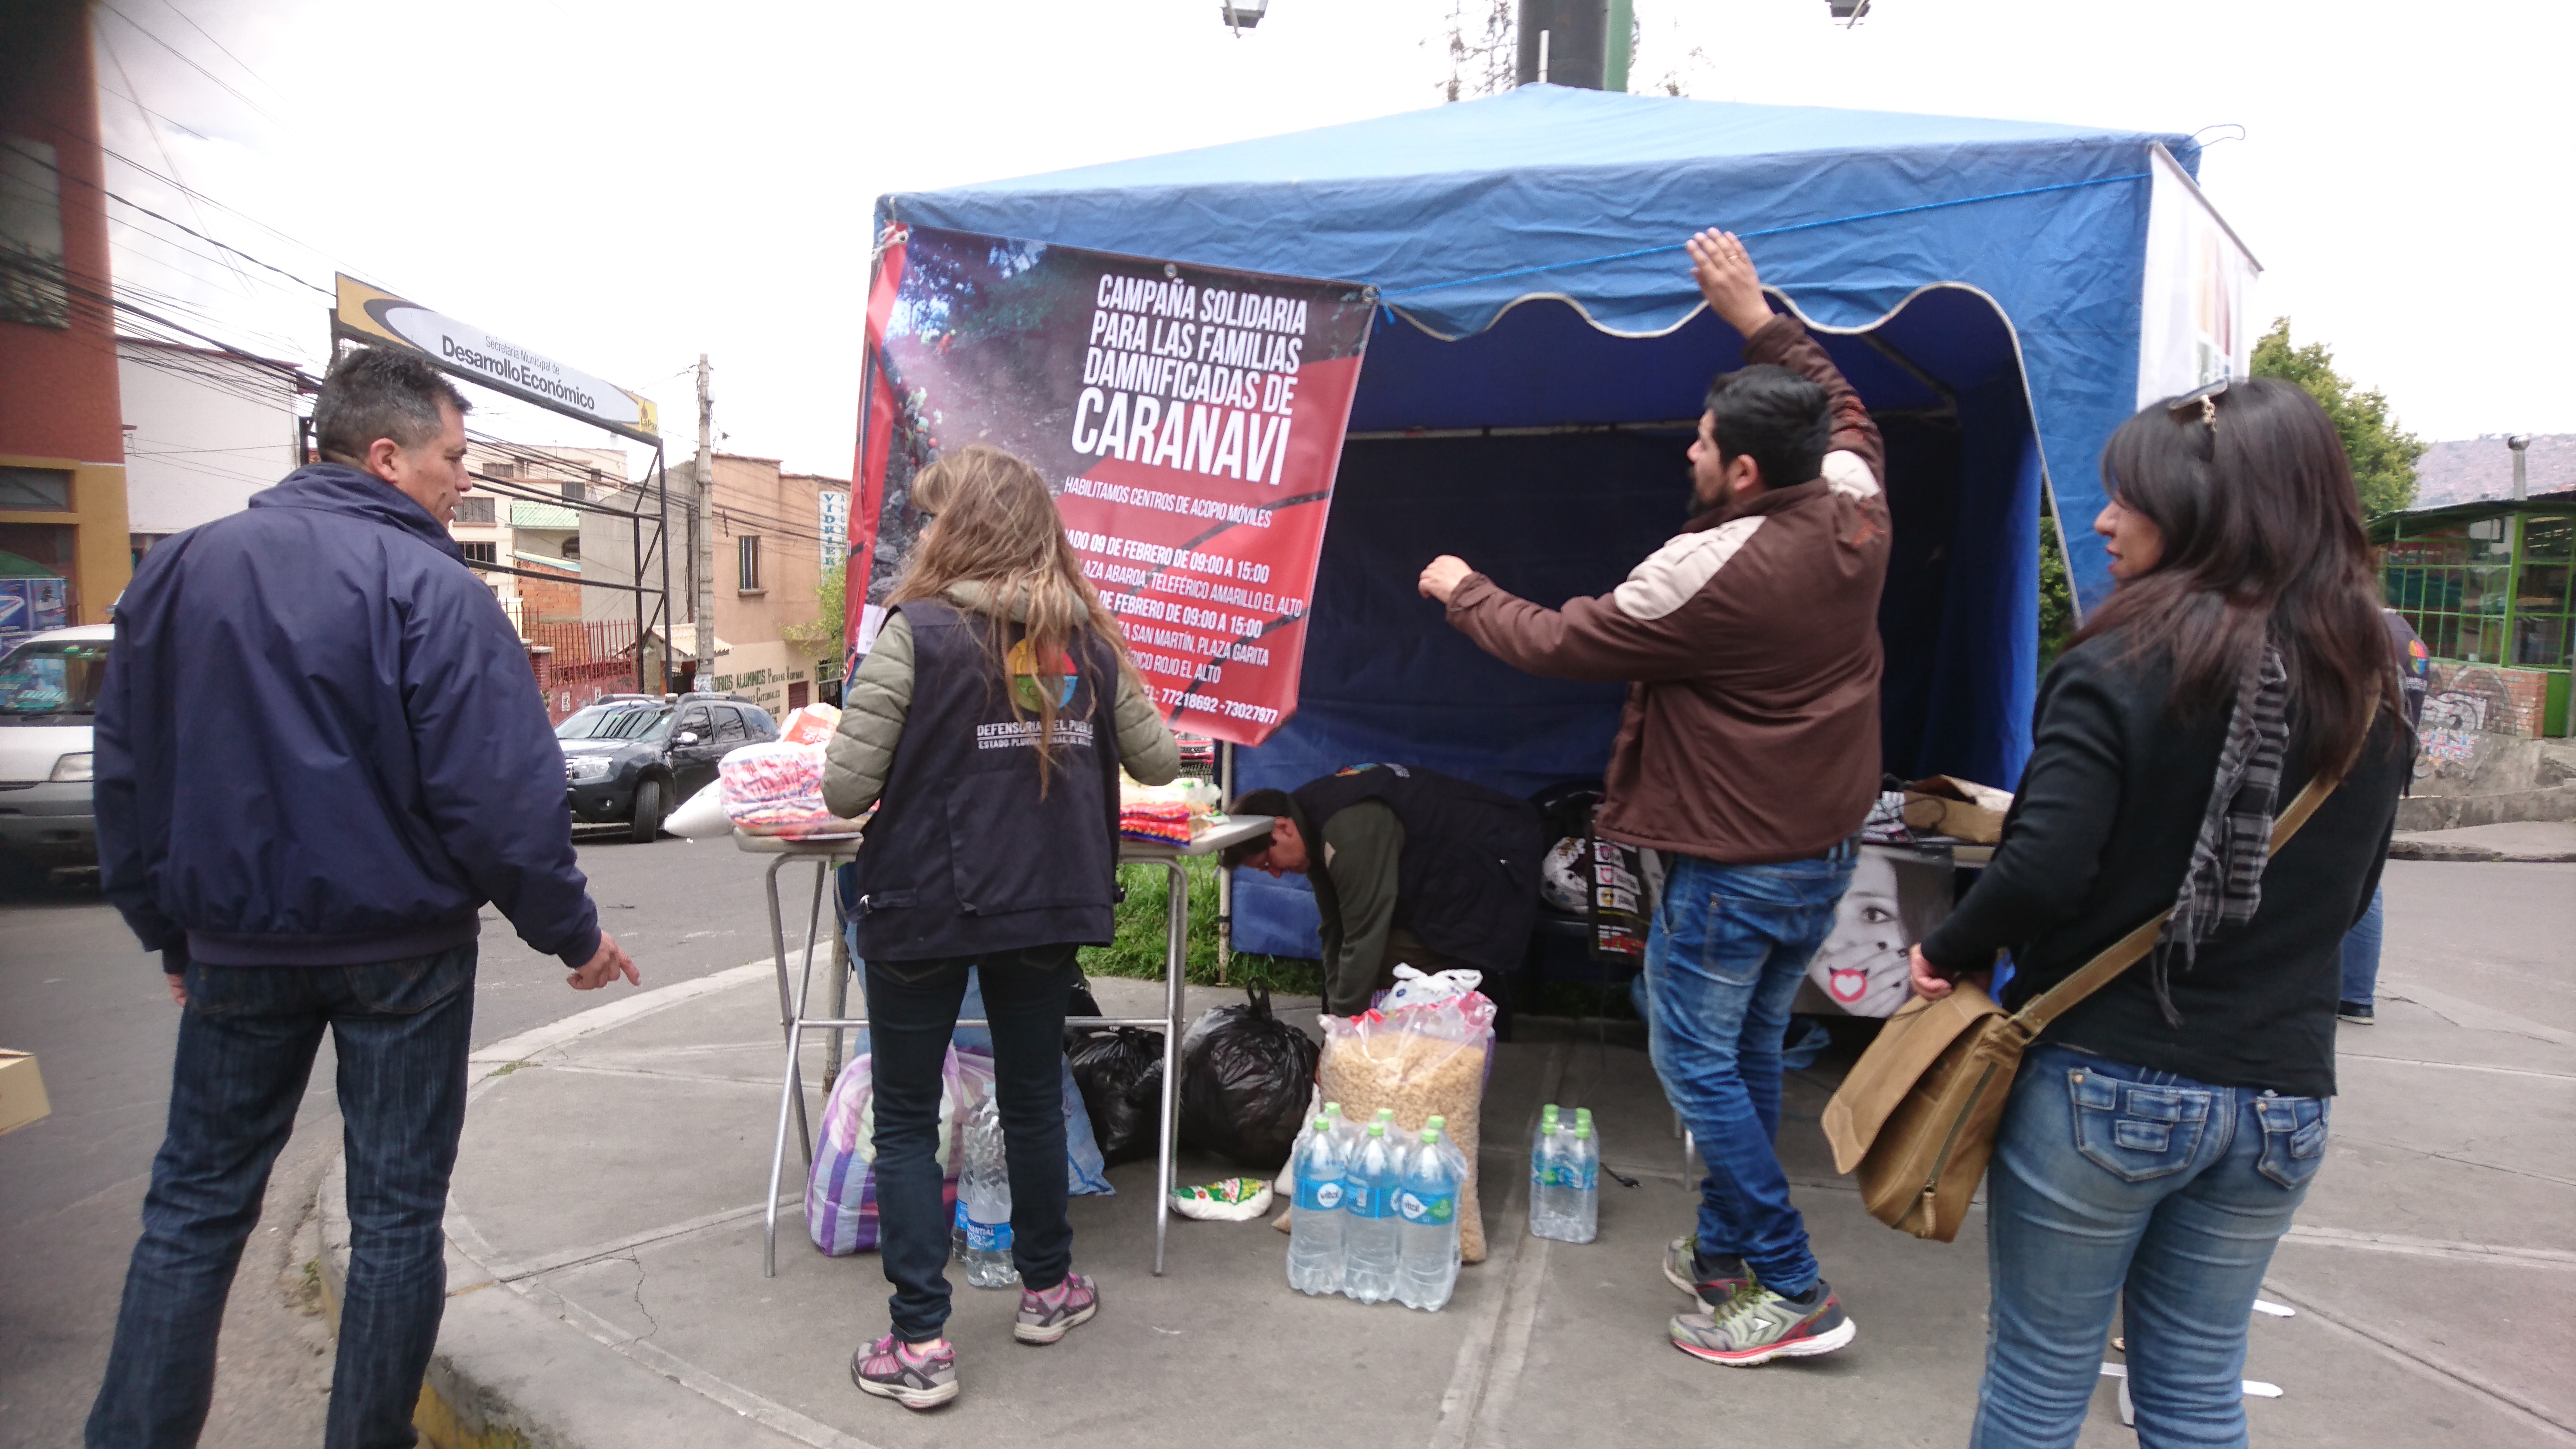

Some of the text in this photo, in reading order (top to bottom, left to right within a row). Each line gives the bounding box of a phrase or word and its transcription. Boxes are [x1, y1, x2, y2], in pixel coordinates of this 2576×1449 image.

[1097, 274, 1307, 335] CAMPAÑA SOLIDARIA
[486, 335, 560, 375] Secretaría Municipal de
[1090, 310, 1303, 375] PARA LAS FAMILIAS
[1083, 346, 1299, 416] DAMNIFICADAS DE
[1071, 387, 1291, 486] CARANAVI
[1064, 476, 1273, 528] HABILITAMOS CENTROS DE ACOPIO MÓVILES
[1065, 529, 1270, 584] ADO 09 DE FEBRERO DE 09:00 A 15:00
[1099, 589, 1263, 639] DE FEBRERO DE 09:00 A 15:00
[1104, 564, 1147, 589] ABAROA,
[1151, 570, 1209, 600] TELEFÉRICO
[1209, 583, 1263, 611] AMARILLO
[1262, 596, 1276, 613] EL
[1276, 598, 1303, 618] ALTO
[1131, 623, 1155, 644] SAN
[1154, 630, 1195, 654] MARTÍN,
[1197, 636, 1231, 659] PLAZA
[1232, 643, 1269, 667] GARITA
[1153, 655, 1180, 676] ROJO
[1180, 663, 1193, 679] EL
[1193, 665, 1221, 684] ALTO
[737, 669, 766, 689] ALUMINIOS
[1053, 719, 1068, 731] EL
[1161, 687, 1217, 714] 77218692
[1219, 700, 1279, 725] -73027977
[978, 739, 1009, 750] ESTADO
